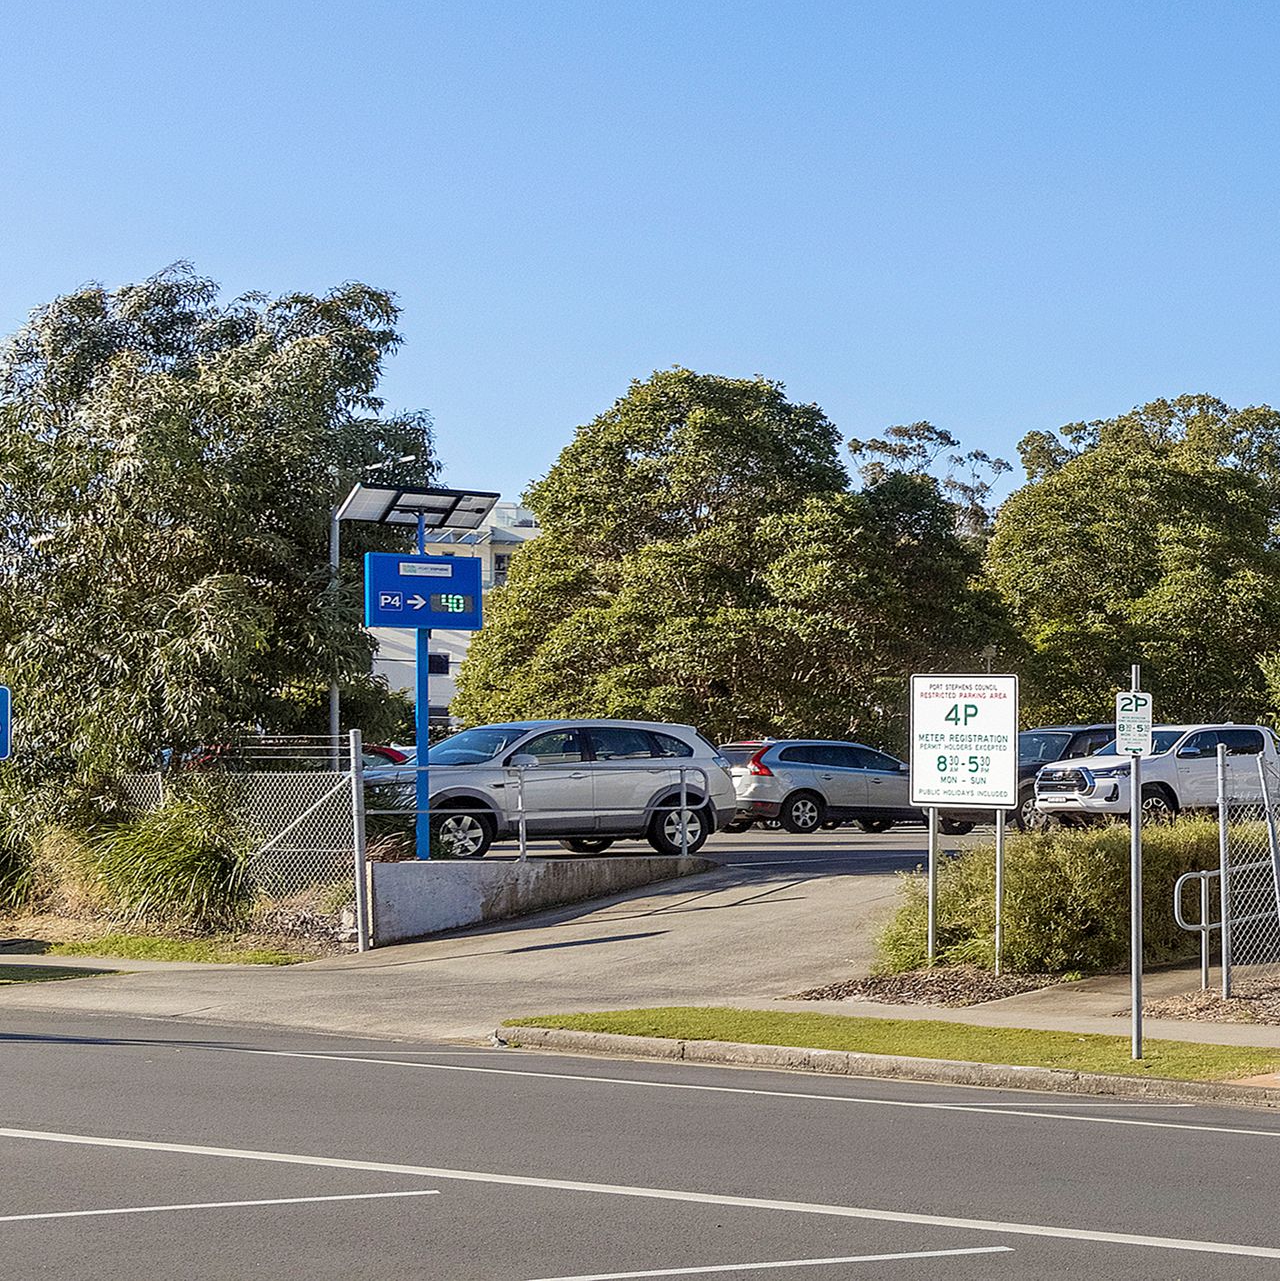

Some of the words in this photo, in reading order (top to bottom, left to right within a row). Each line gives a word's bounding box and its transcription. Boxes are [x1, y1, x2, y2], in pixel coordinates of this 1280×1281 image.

[381, 595, 401, 607] P4
[441, 594, 464, 612] 40
[1121, 696, 1148, 712] 2P
[944, 704, 978, 726] 4P
[919, 734, 945, 742] METER
[949, 734, 1008, 743] REGISTRATION
[940, 776, 957, 784] MON
[970, 776, 986, 784] SUN
